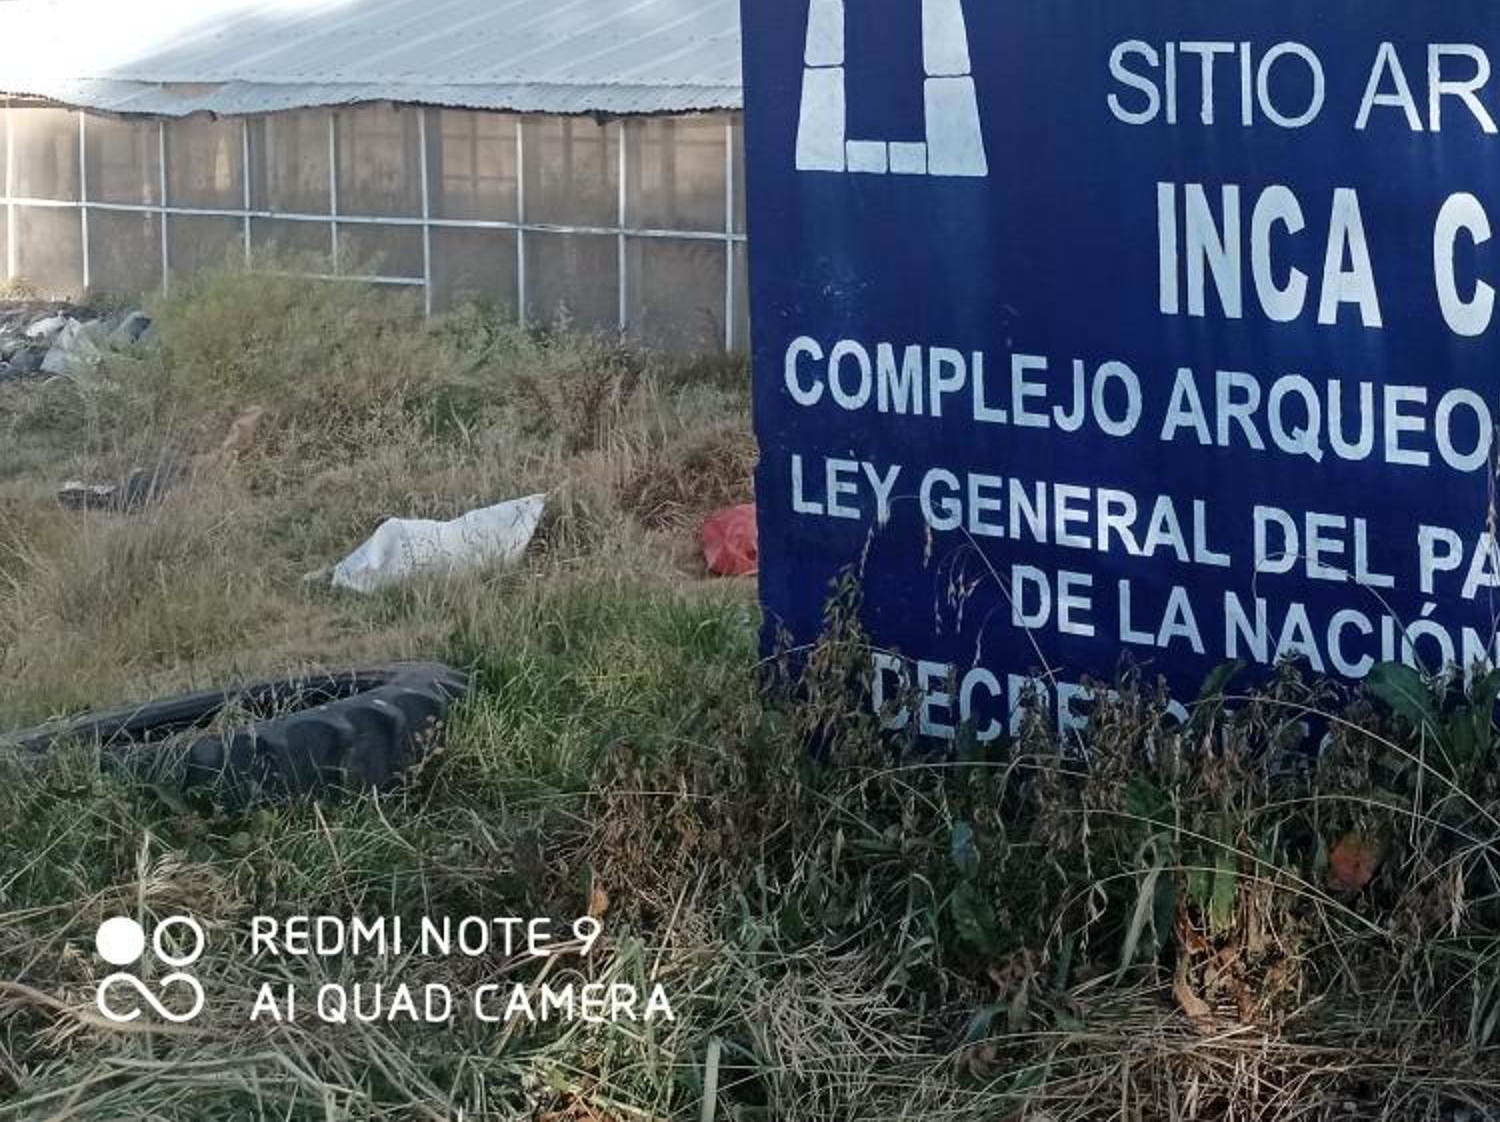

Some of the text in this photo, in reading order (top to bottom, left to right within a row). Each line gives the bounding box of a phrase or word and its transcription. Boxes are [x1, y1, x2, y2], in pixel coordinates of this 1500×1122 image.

[1107, 39, 1326, 126] SITIO
[1157, 181, 1382, 329] INCA
[785, 336, 1142, 437] COMPLEJO
[791, 455, 900, 523] LEY
[920, 468, 1230, 567] GENERAL
[1254, 505, 1394, 588] DEL
[1011, 565, 1095, 637] DE
[1119, 579, 1205, 654] LA
